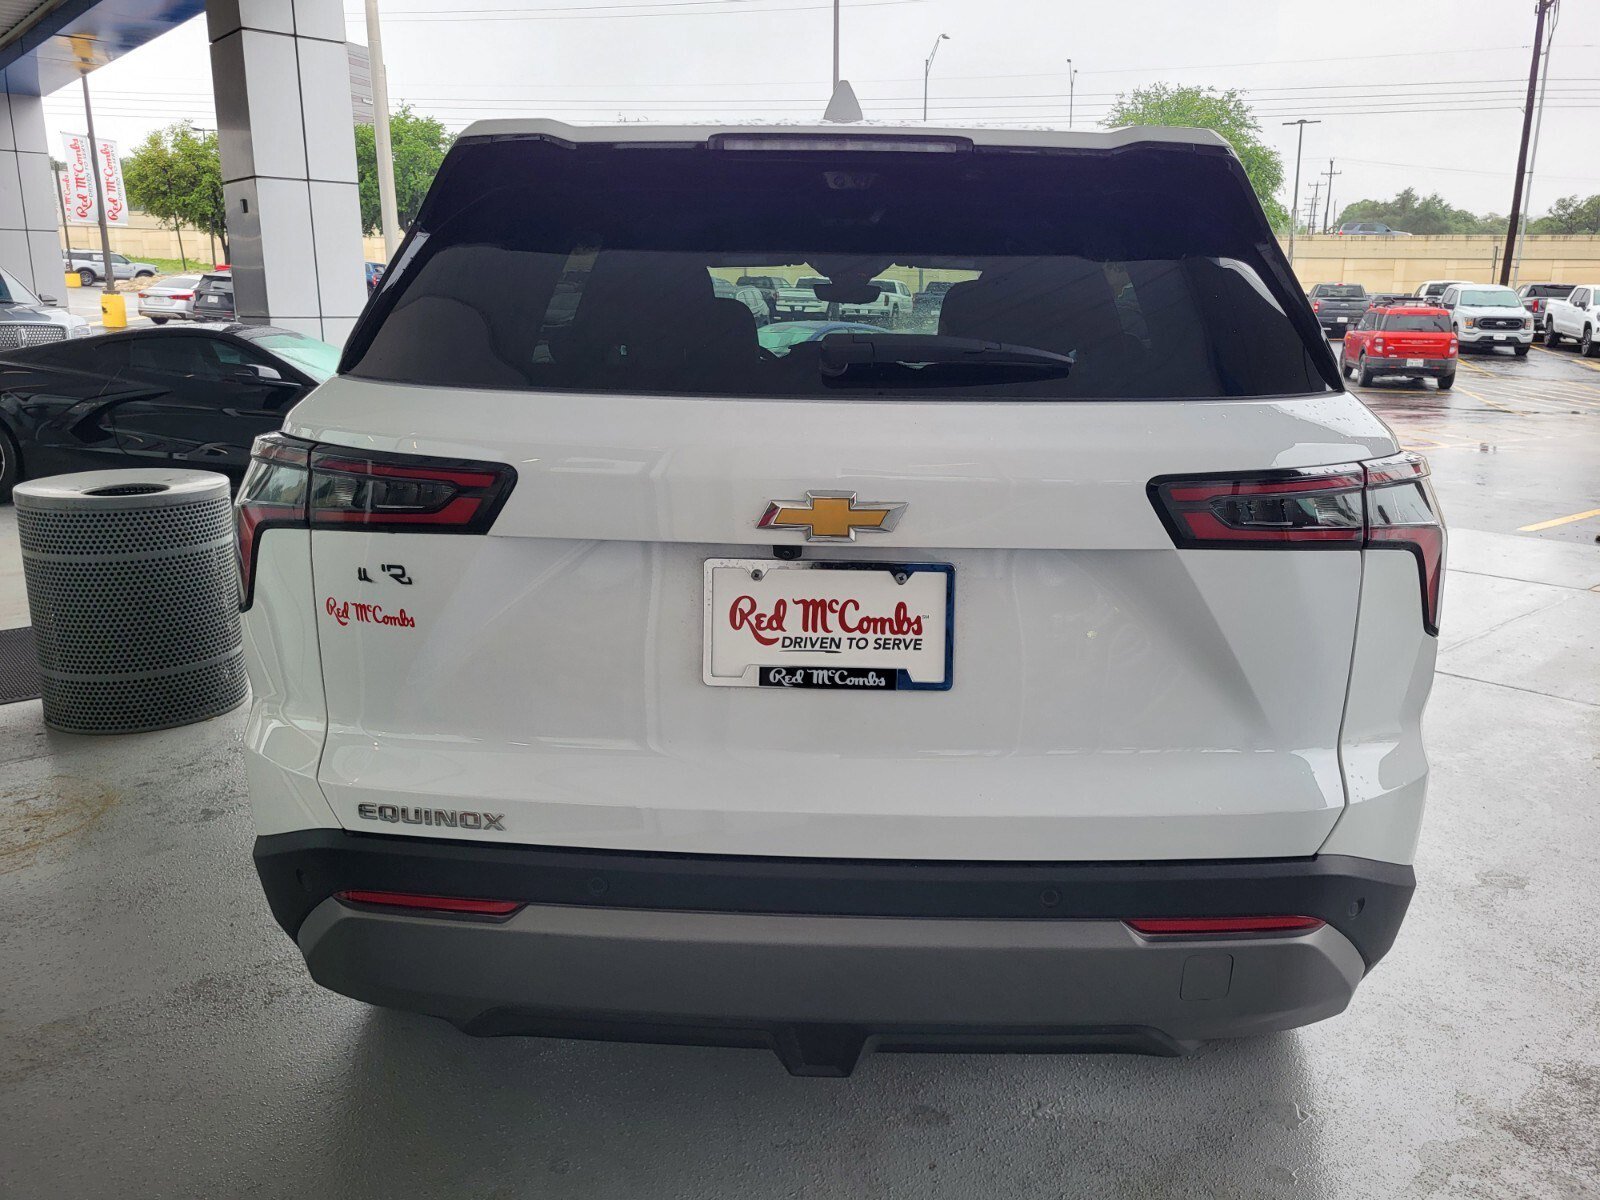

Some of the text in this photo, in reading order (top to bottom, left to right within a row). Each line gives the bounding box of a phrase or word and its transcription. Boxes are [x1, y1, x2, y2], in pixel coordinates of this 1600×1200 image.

[69, 138, 87, 192] McCombs
[100, 143, 122, 221] Red McCombs
[76, 193, 92, 218] Red
[325, 596, 415, 628] Red McCombs
[729, 595, 787, 646] Red
[792, 597, 923, 636] McCombs
[781, 636, 923, 651] DRIVEN TO SERVE
[769, 667, 886, 687] Red McCombs
[358, 802, 507, 831] EQUINOX
